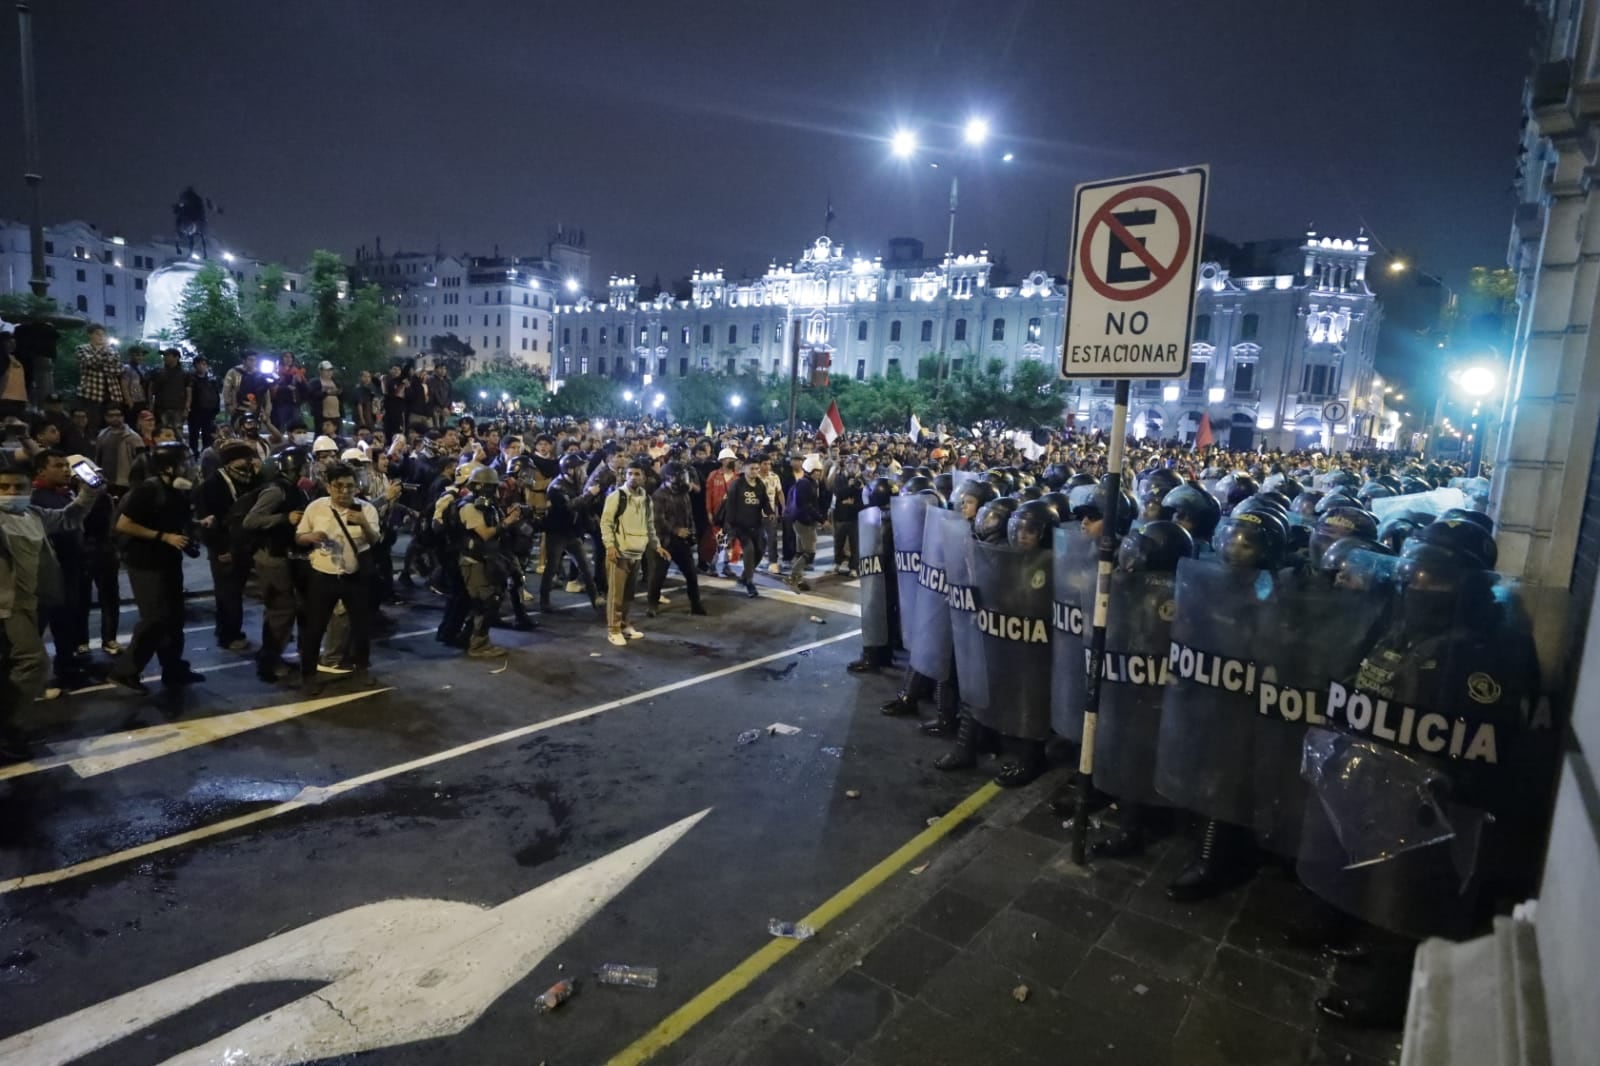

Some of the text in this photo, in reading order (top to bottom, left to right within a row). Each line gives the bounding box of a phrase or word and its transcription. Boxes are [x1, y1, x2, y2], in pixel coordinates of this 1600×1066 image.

[1105, 311, 1148, 335] NO
[1072, 344, 1177, 363] ESTACIONAR
[1326, 681, 1498, 764] POLICIA
